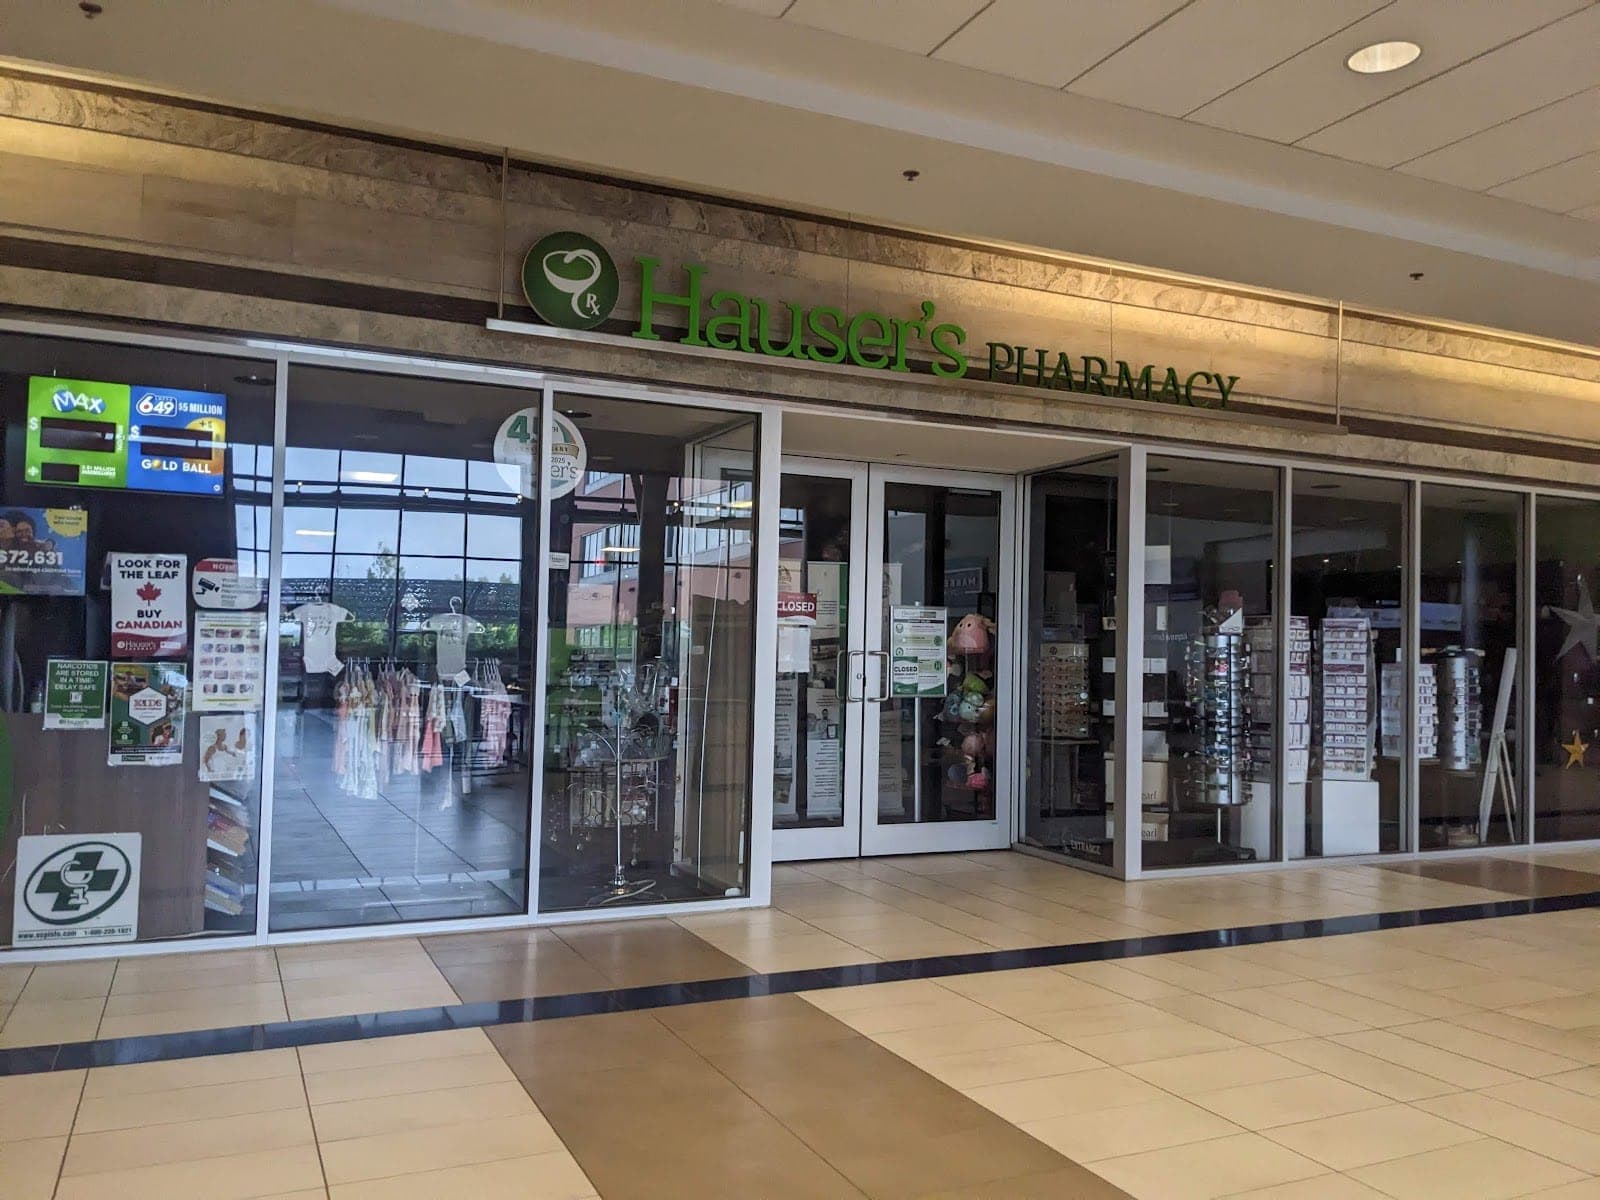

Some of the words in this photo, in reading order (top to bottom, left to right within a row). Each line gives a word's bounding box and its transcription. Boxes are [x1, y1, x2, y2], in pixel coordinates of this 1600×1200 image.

[632, 255, 968, 379] Hauser's
[986, 342, 1240, 408] PHARMACY
[53, 390, 103, 414] MAX
[189, 403, 223, 415] MILLION
[182, 463, 212, 474] BALL
[118, 559, 151, 568] LOOK
[156, 560, 181, 568] FOR
[120, 570, 143, 579] THE
[148, 571, 179, 579] LEAF
[137, 609, 162, 618] BUY
[115, 621, 182, 629] CANADIAN
